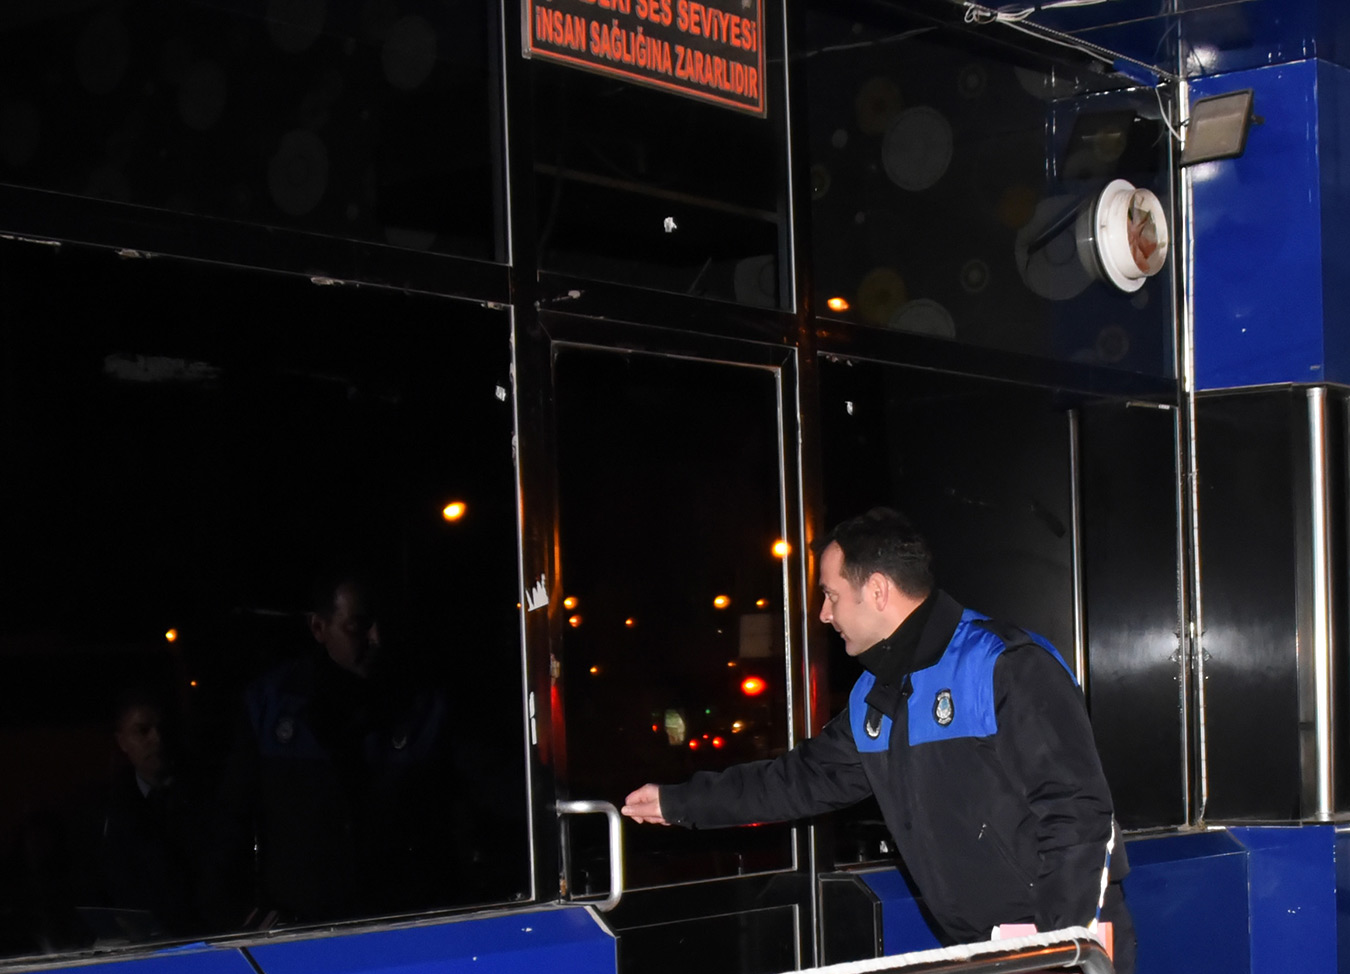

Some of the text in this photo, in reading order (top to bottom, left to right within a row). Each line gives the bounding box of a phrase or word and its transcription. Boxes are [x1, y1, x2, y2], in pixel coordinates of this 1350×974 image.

[635, 0, 672, 27] SES
[589, 18, 673, 76] SAĞLIĞINA
[675, 44, 758, 99] ZARARLIDIR
